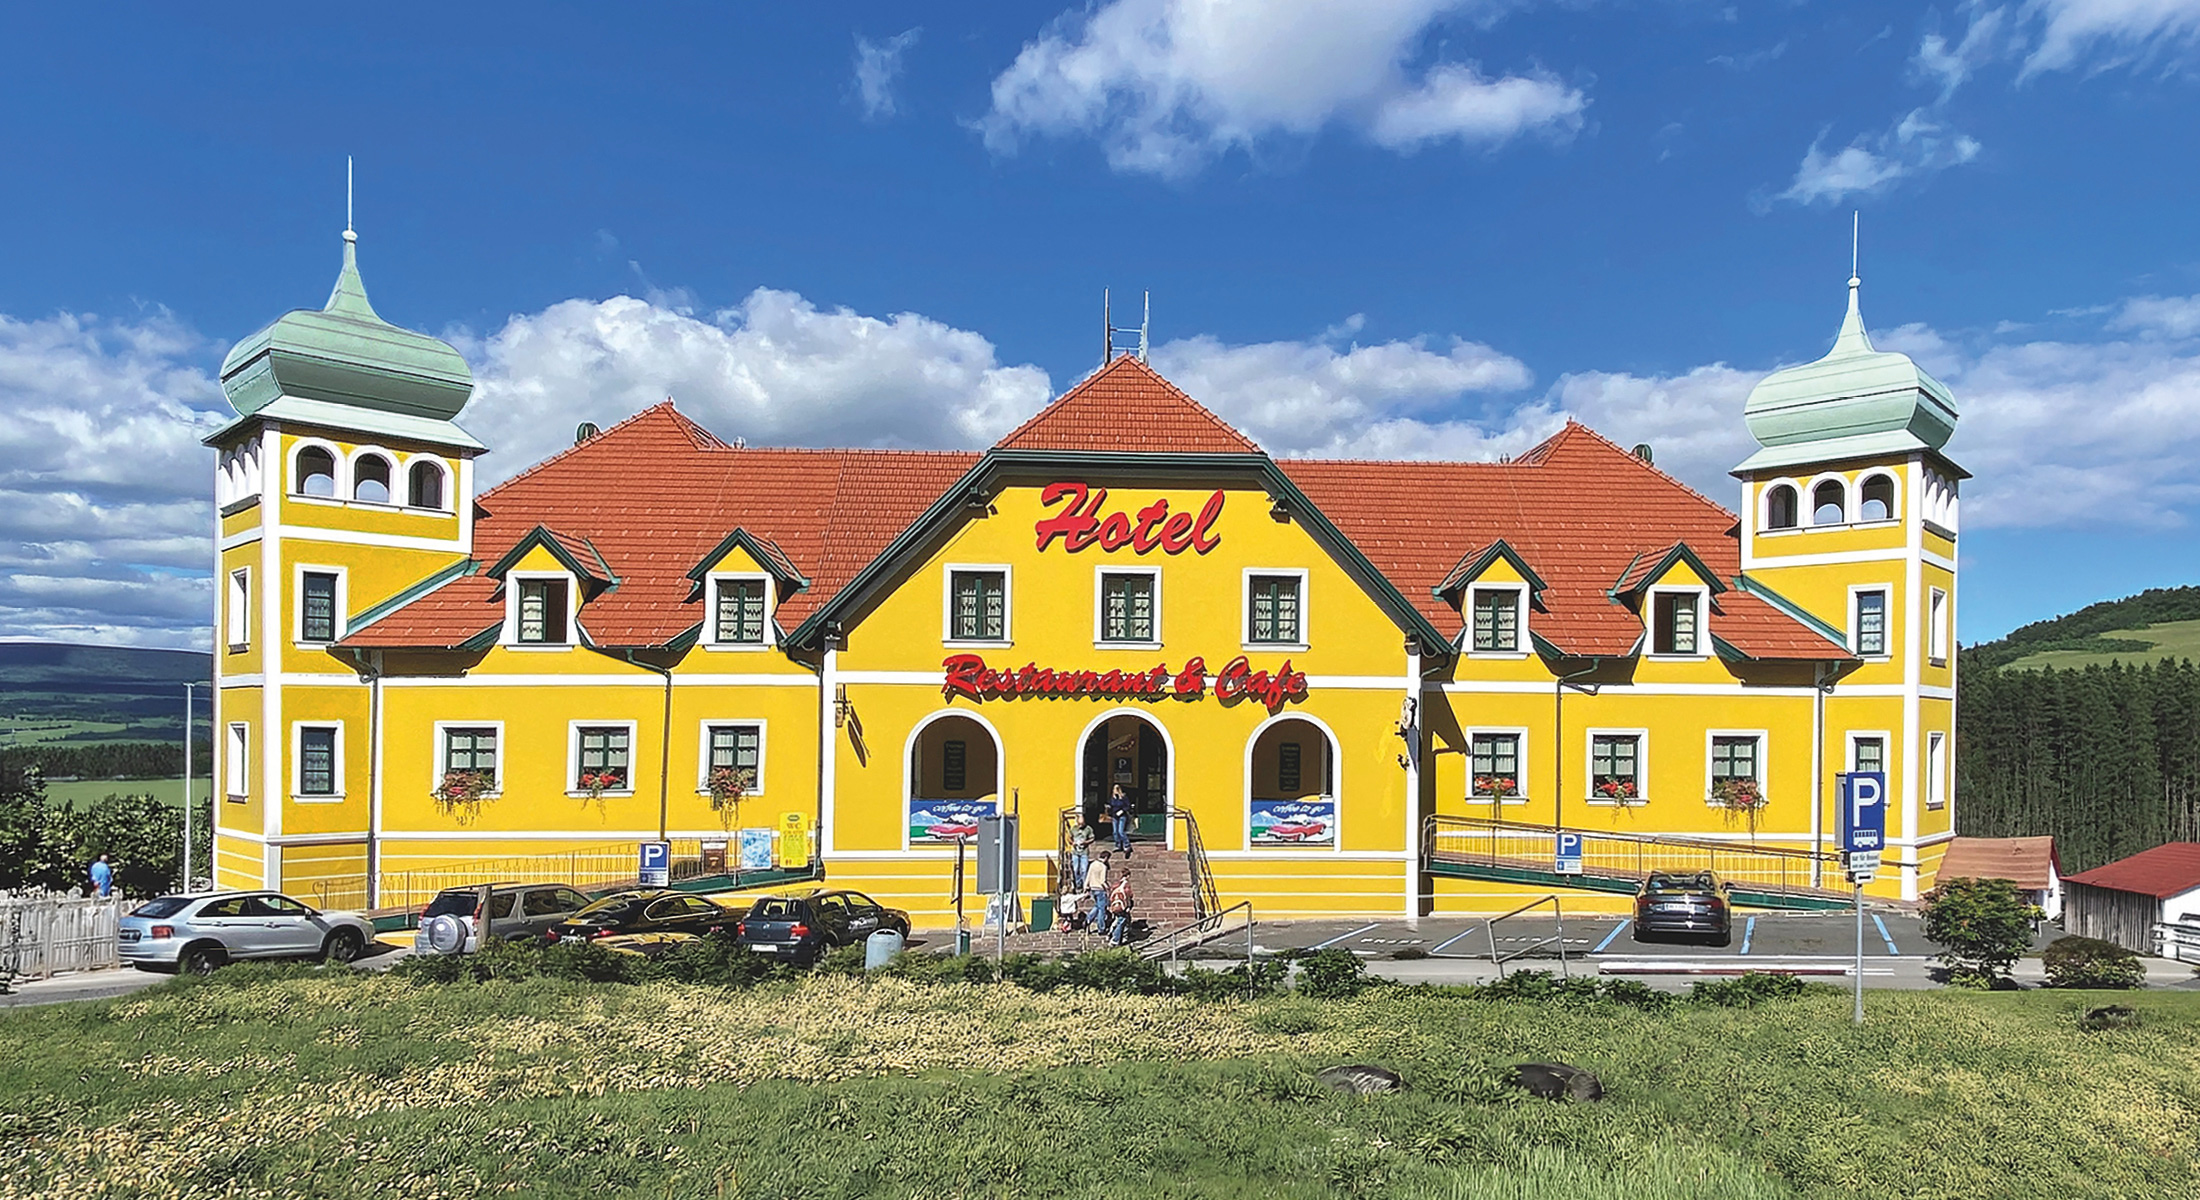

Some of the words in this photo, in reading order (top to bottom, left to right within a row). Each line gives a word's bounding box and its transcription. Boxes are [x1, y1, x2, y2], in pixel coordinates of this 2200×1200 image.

[1035, 482, 1224, 555] Hotel
[941, 653, 1168, 697] Restaurant
[1174, 656, 1206, 697] &
[932, 803, 961, 813] coffee
[971, 805, 988, 815] go
[1272, 803, 1300, 813] coffee
[1310, 805, 1326, 815] go
[1853, 777, 1881, 828] P
[645, 844, 664, 867] P
[1560, 834, 1578, 855] P
